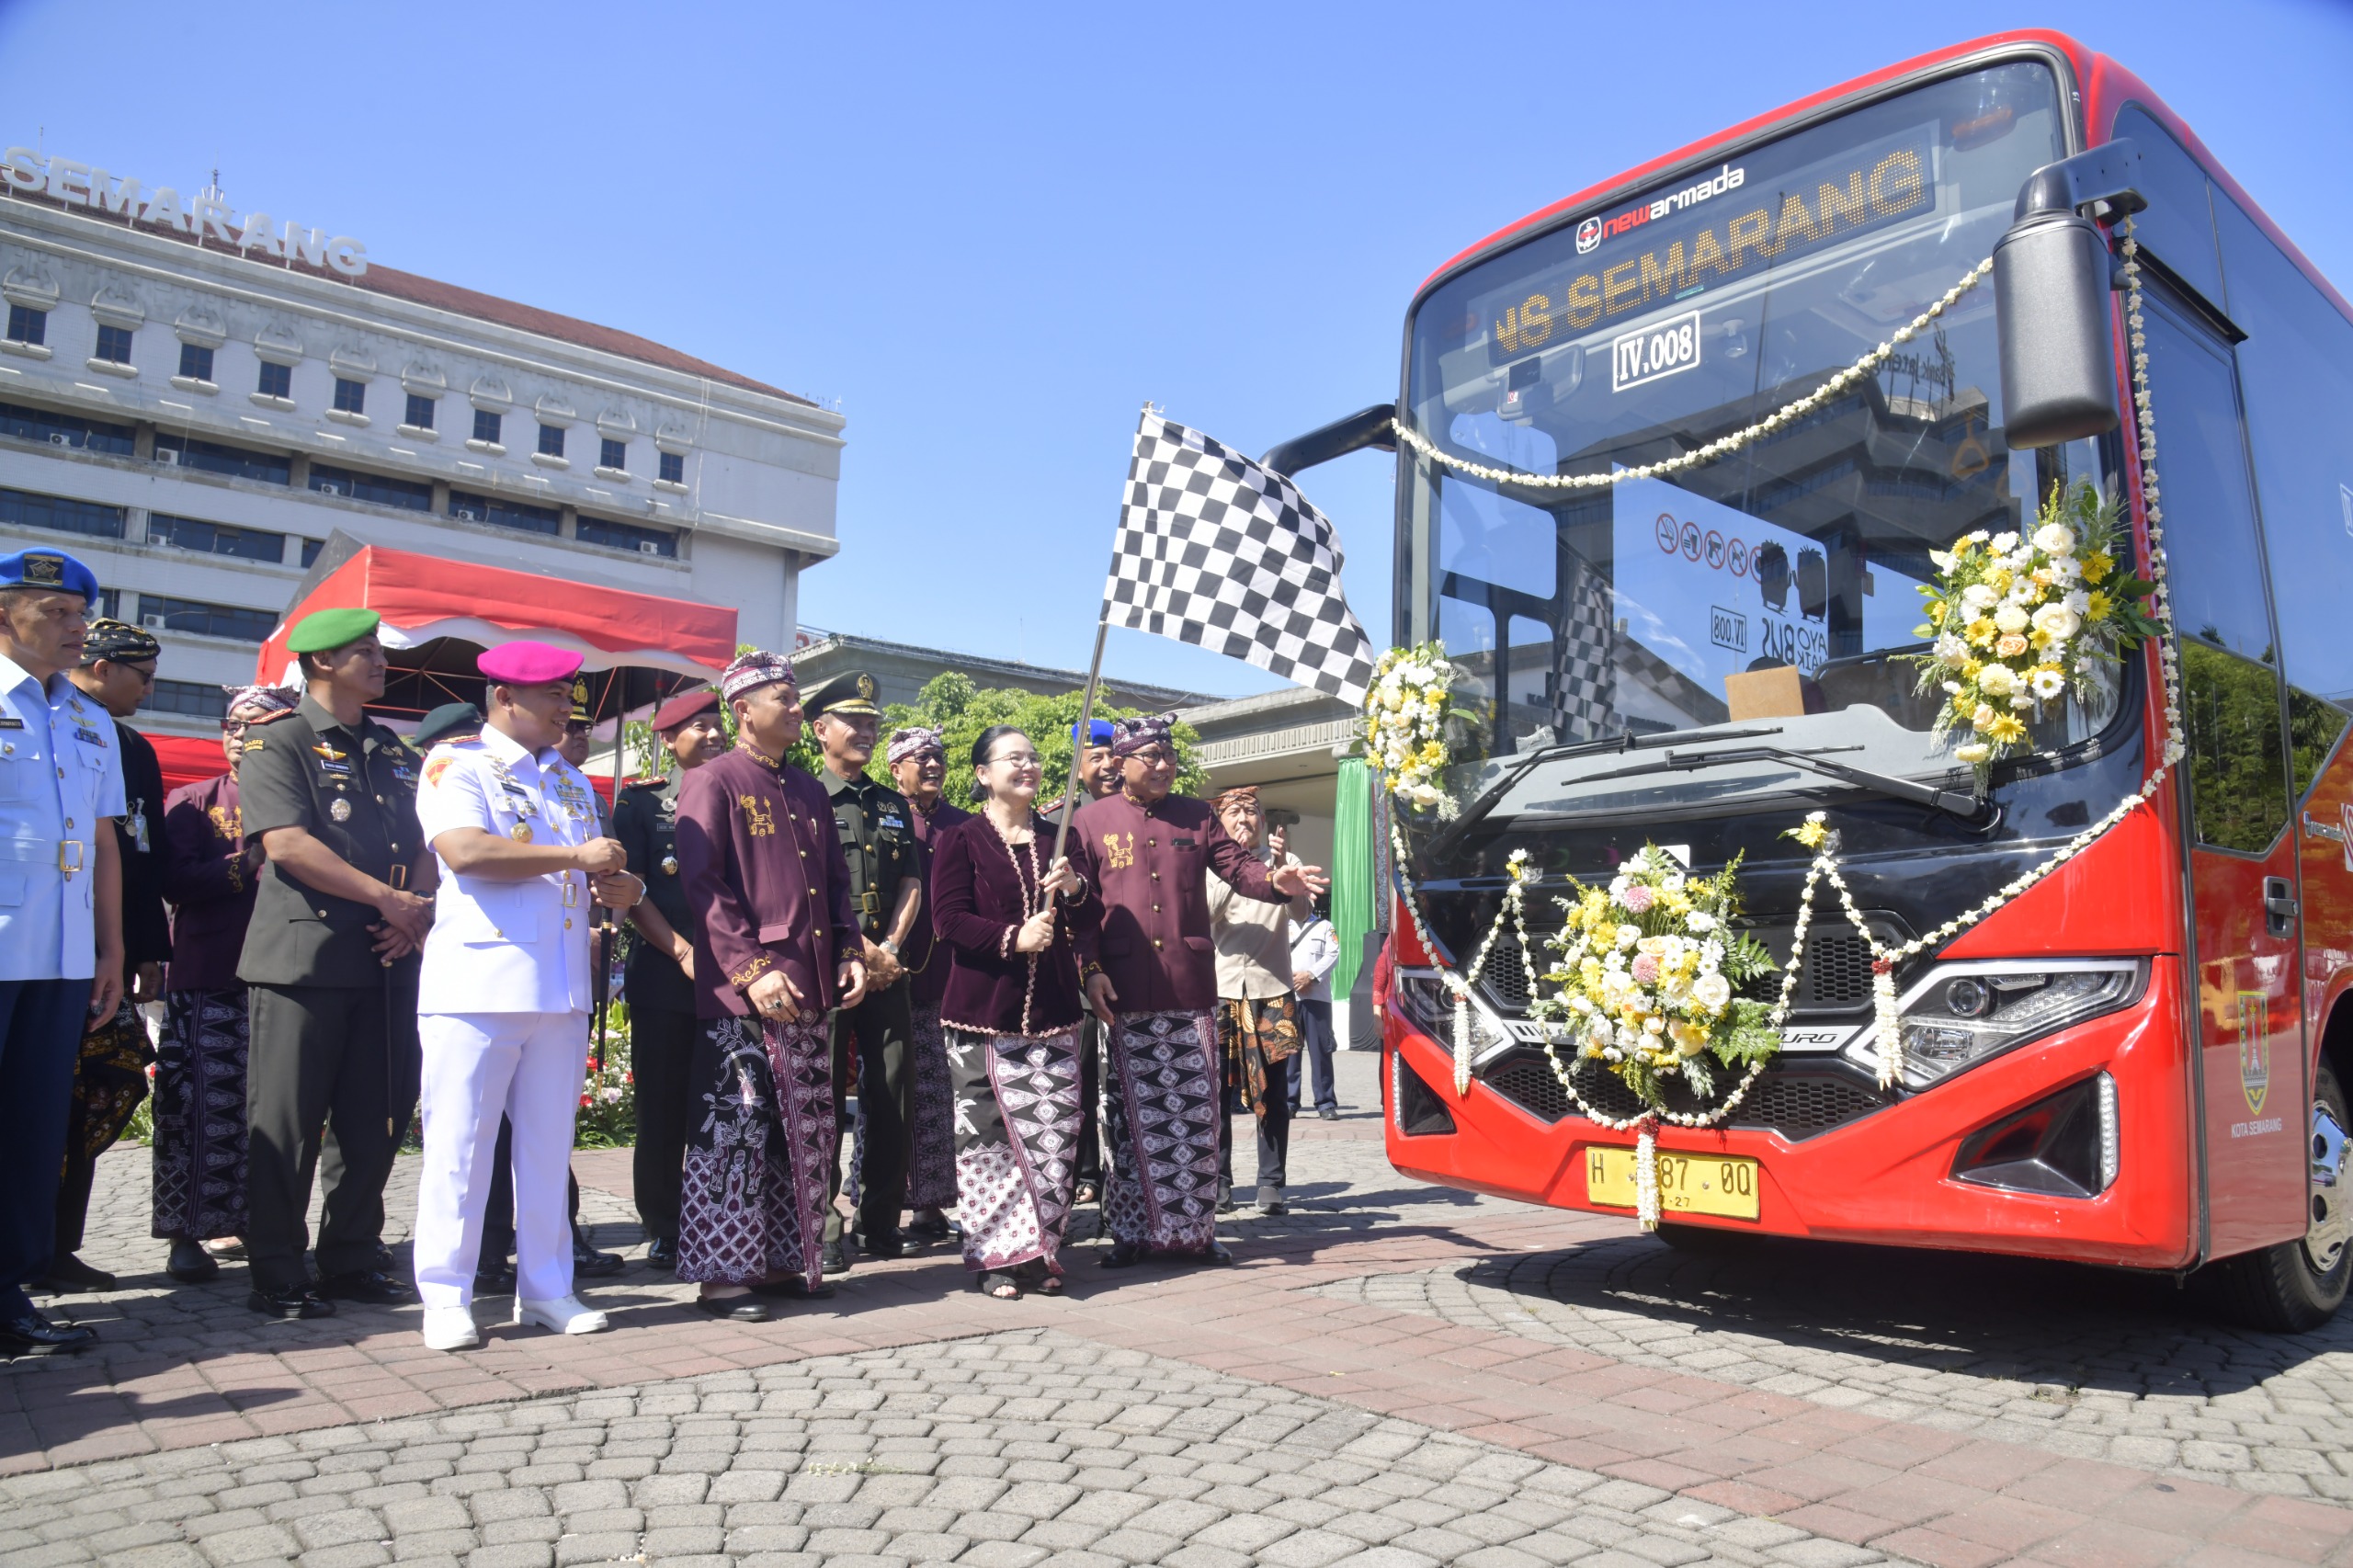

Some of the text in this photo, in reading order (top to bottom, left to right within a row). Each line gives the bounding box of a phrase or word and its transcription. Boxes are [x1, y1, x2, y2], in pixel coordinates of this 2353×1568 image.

[1, 146, 368, 276] SEMARANG
[1603, 165, 1745, 239] newarmada
[1566, 151, 1922, 330] SEMARANG
[1620, 324, 1693, 381] IV.008
[2231, 1118, 2282, 1139] KOTA SEMARANG
[1592, 1153, 1605, 1184] H
